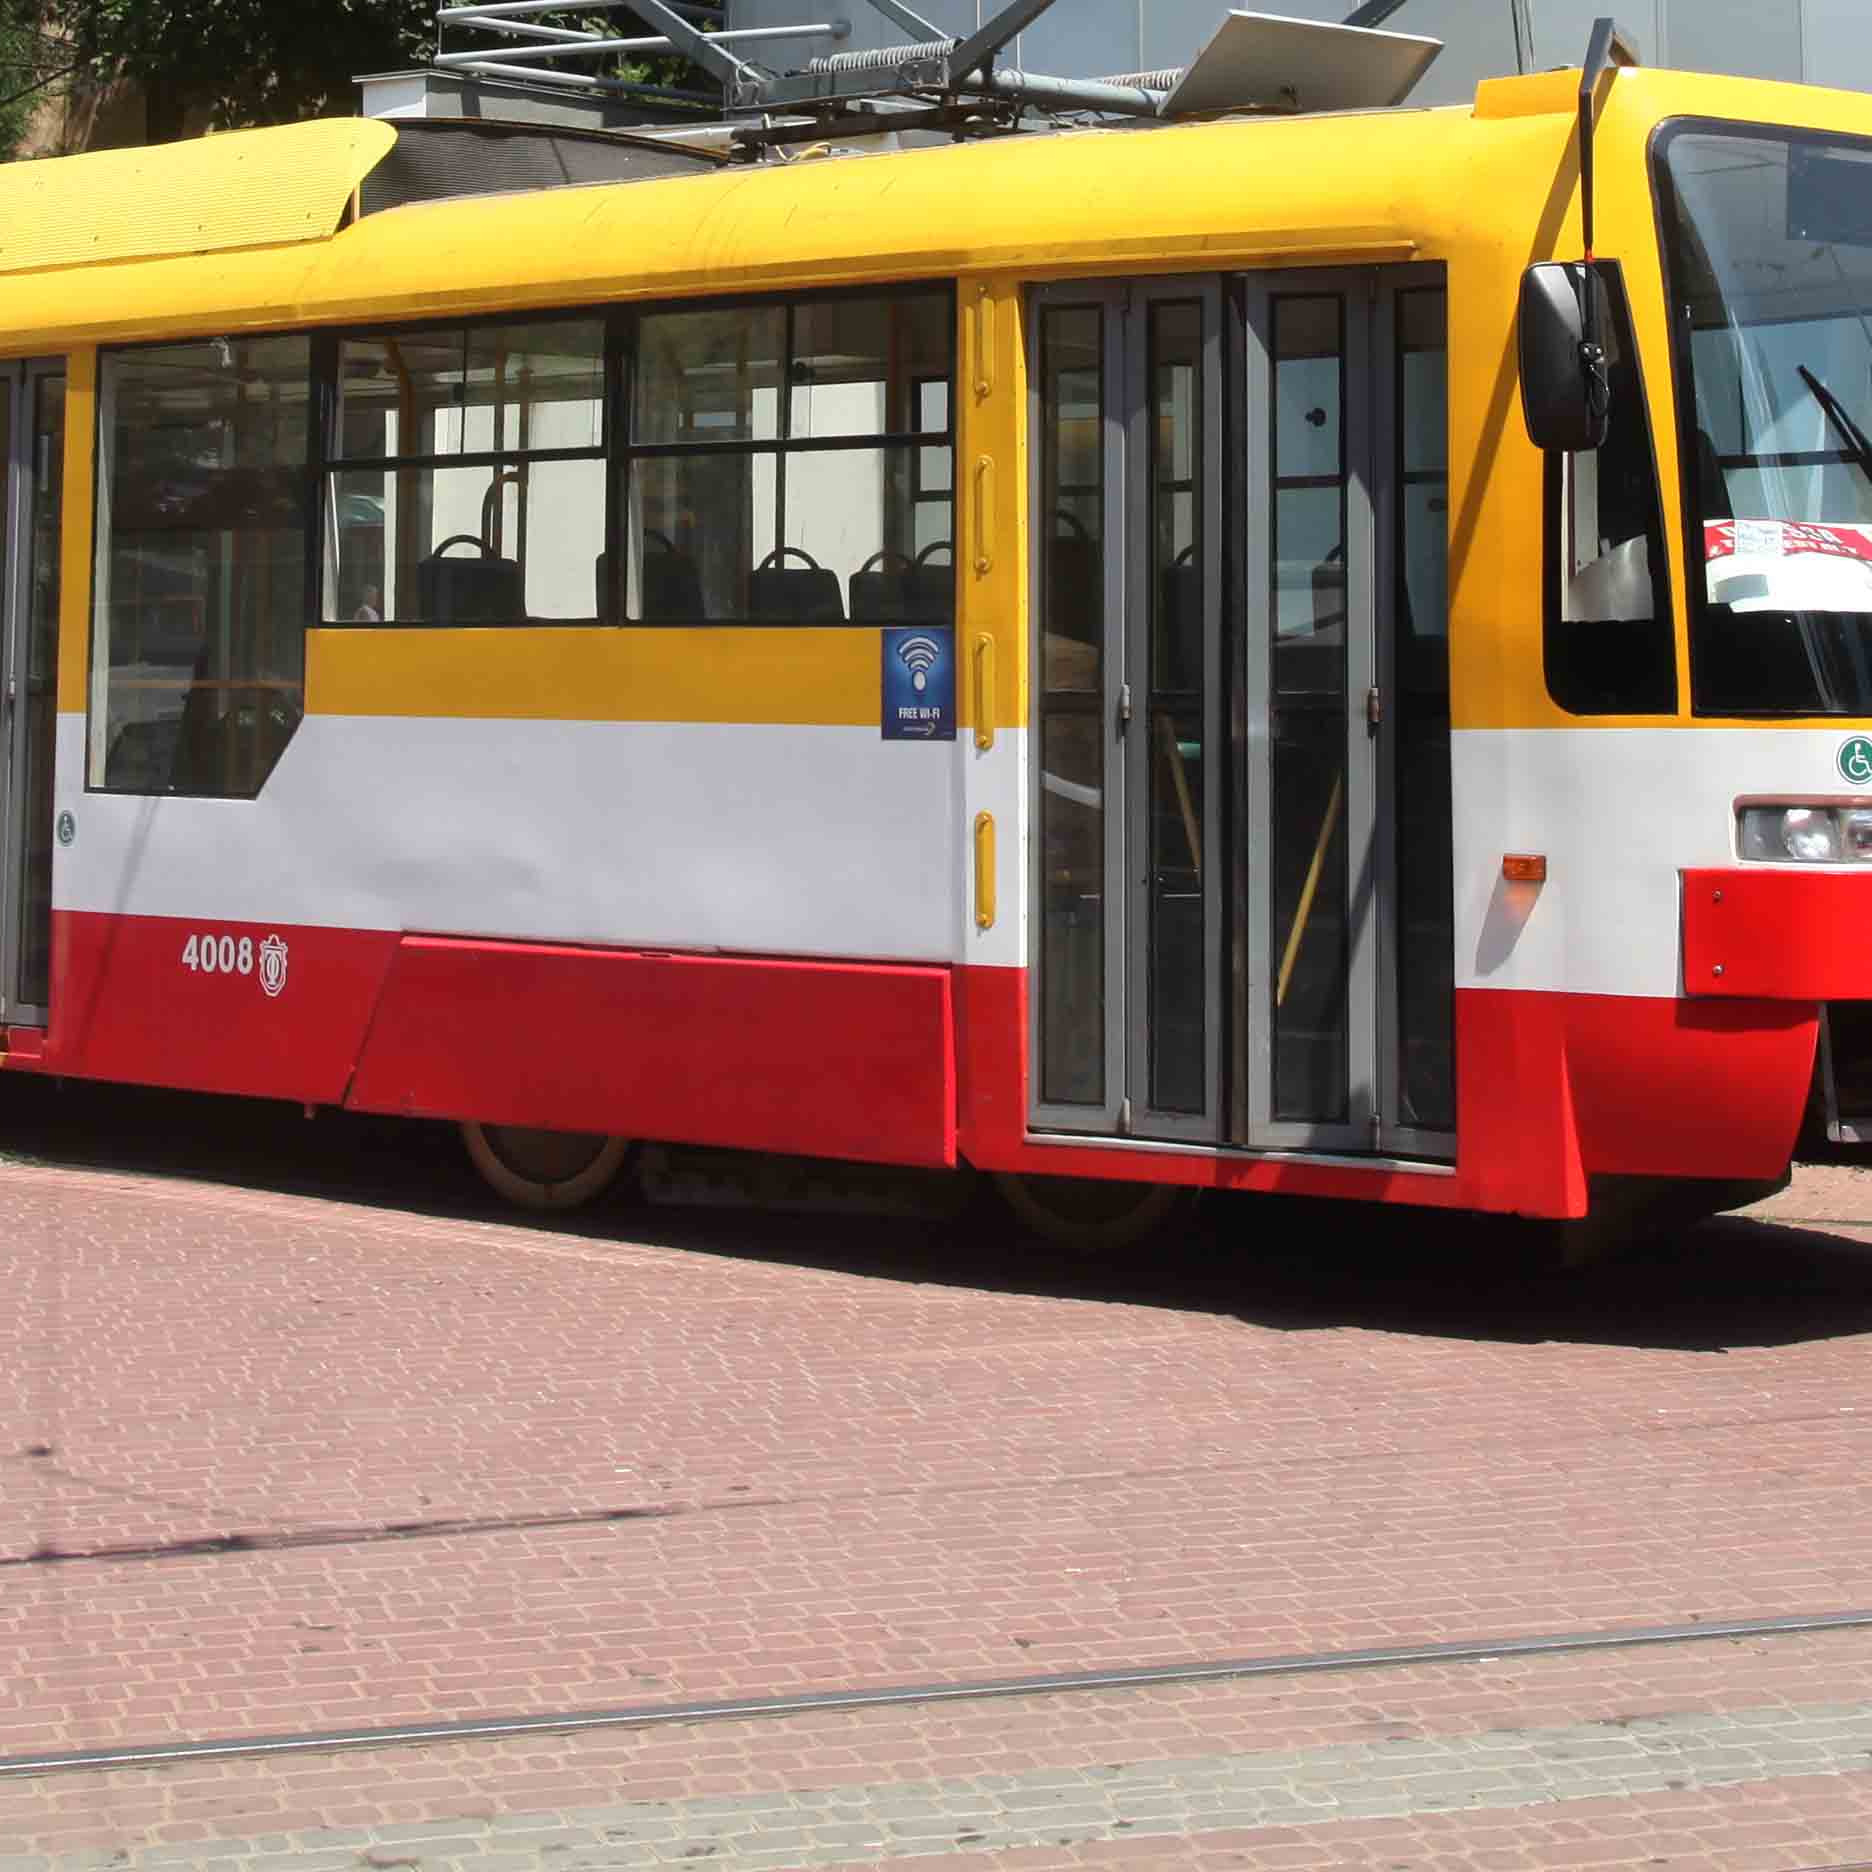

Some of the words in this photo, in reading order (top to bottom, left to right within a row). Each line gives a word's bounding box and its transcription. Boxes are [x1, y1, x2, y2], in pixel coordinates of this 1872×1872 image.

[898, 707, 918, 720] FREE
[920, 707, 940, 720] WI-FI
[182, 934, 253, 975] 4008
